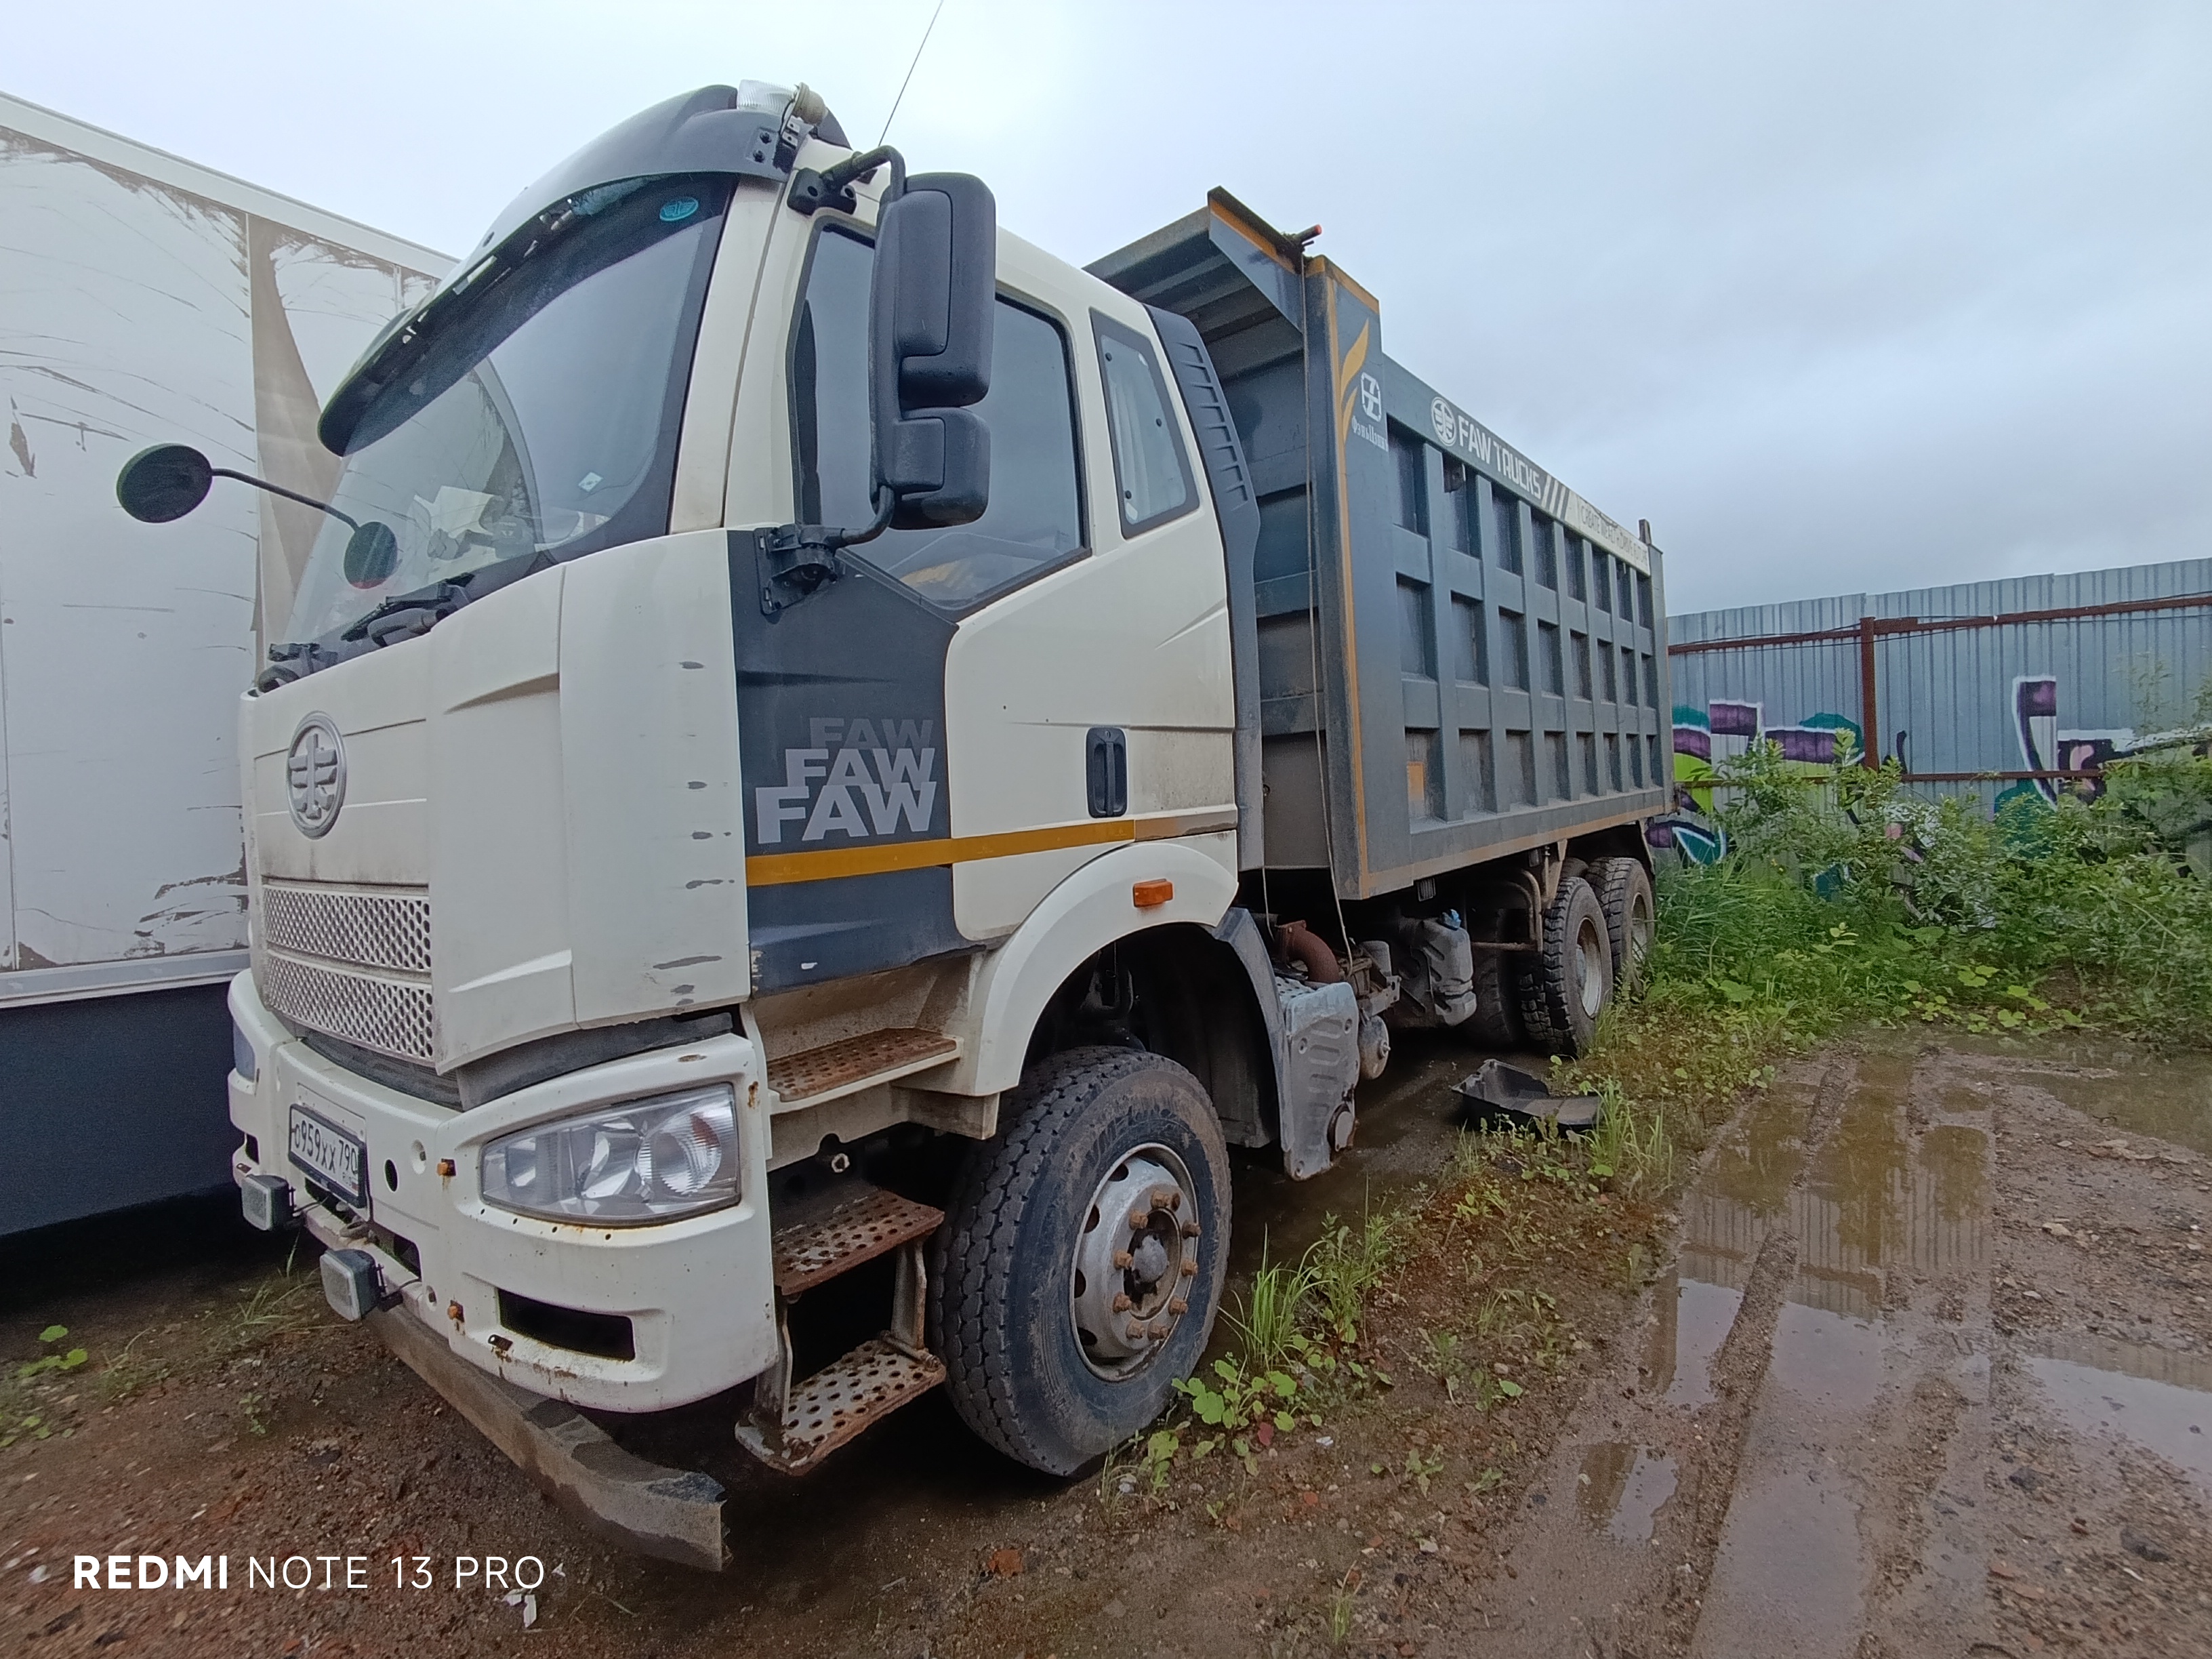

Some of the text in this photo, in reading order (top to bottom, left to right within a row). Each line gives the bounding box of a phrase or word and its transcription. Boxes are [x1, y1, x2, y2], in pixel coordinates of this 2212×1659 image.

[1458, 415, 1541, 499] FAW TRUCKS
[809, 718, 933, 756] FAW
[785, 747, 935, 792] FAW
[756, 781, 937, 844] FAW
